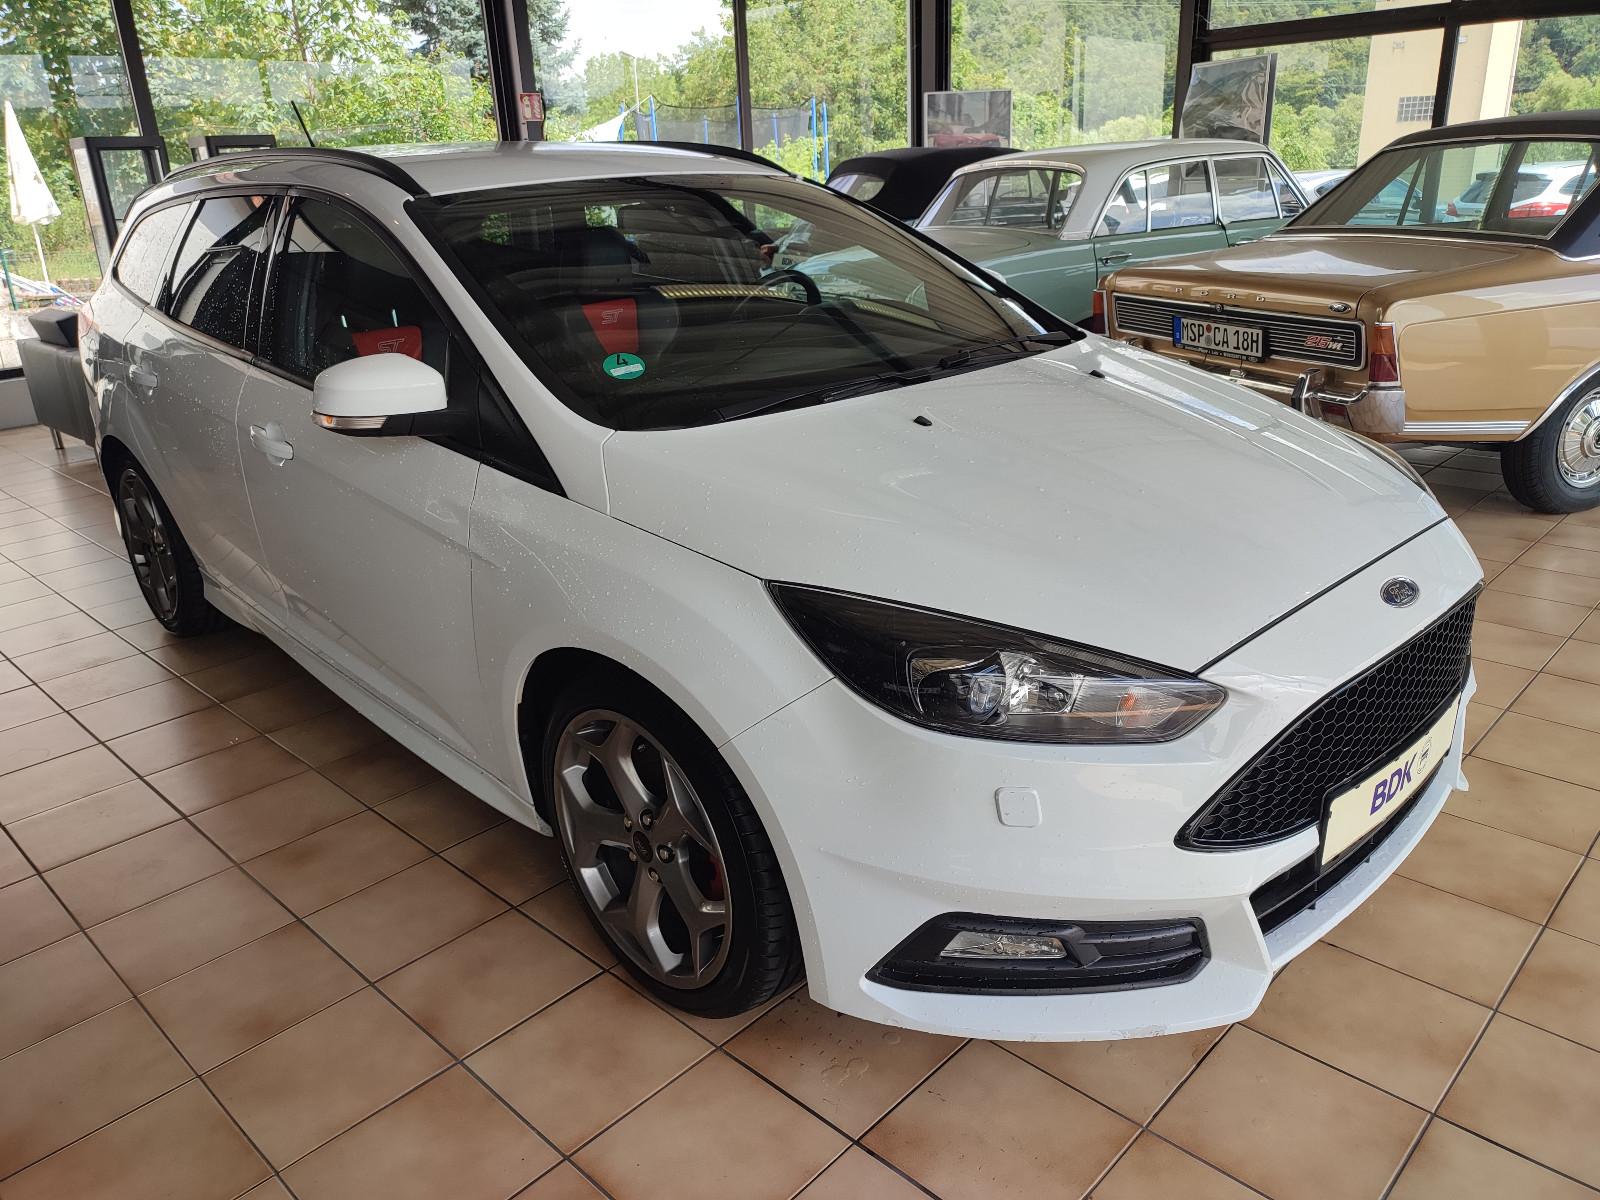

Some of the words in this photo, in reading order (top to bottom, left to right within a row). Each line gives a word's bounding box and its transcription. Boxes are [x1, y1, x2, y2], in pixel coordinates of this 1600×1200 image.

[601, 307, 624, 325] ST
[1182, 321, 1204, 343] MSP
[1213, 326, 1230, 349] CA
[1233, 329, 1260, 353] 18H
[616, 354, 629, 366] 4
[1369, 751, 1418, 816] BDK
